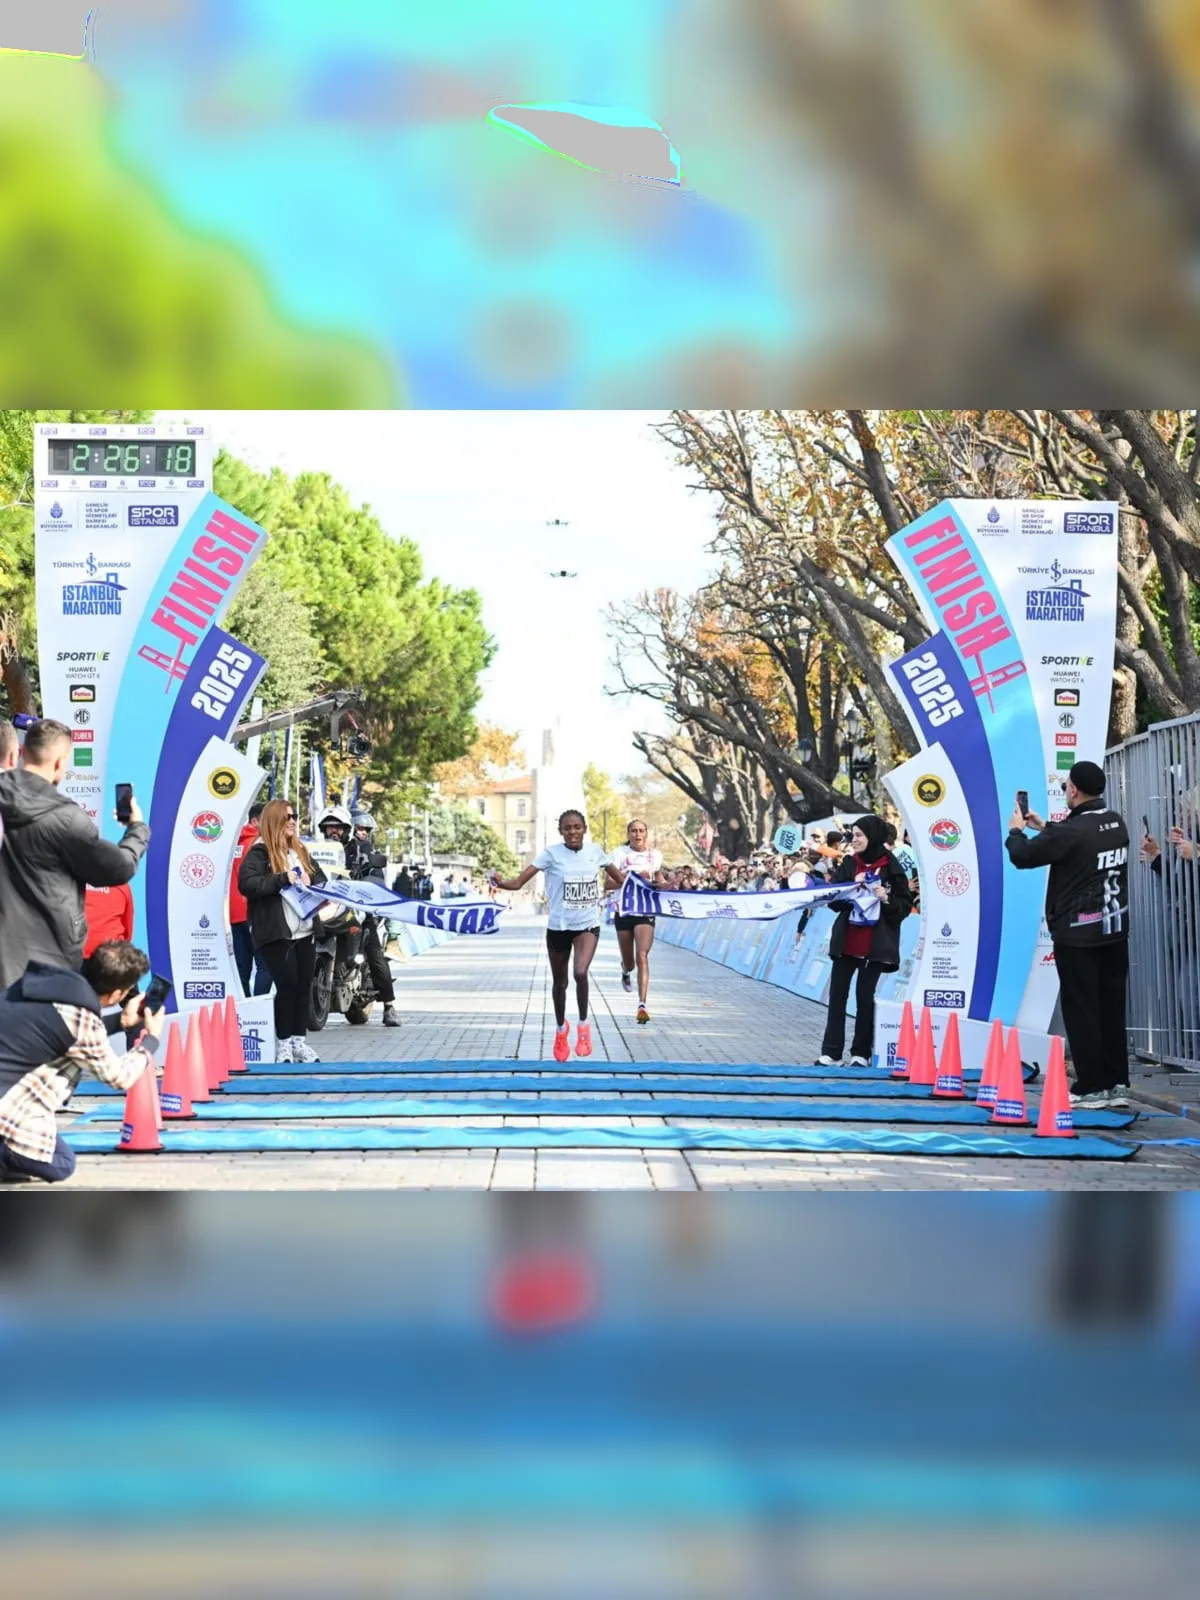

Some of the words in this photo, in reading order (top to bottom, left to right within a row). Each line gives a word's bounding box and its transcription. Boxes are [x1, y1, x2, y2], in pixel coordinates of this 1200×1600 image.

[72, 445, 192, 473] 2:26:18
[131, 507, 175, 518] SPOR
[1066, 514, 1110, 526] SPOR
[52, 560, 85, 568] TÜRKİYE
[1017, 566, 1049, 574] TÜRKİYE
[151, 509, 260, 647] FINISH
[904, 515, 1012, 658] FINISH
[62, 601, 121, 615] MARATONU
[1026, 607, 1084, 621] MARATHON
[56, 652, 110, 661] SPORTIVE
[1041, 656, 1094, 666] SPORTIVE
[190, 642, 252, 721] 2025
[902, 651, 964, 728] 2025
[186, 983, 222, 992] SPOR
[926, 992, 962, 1000] SPOR
